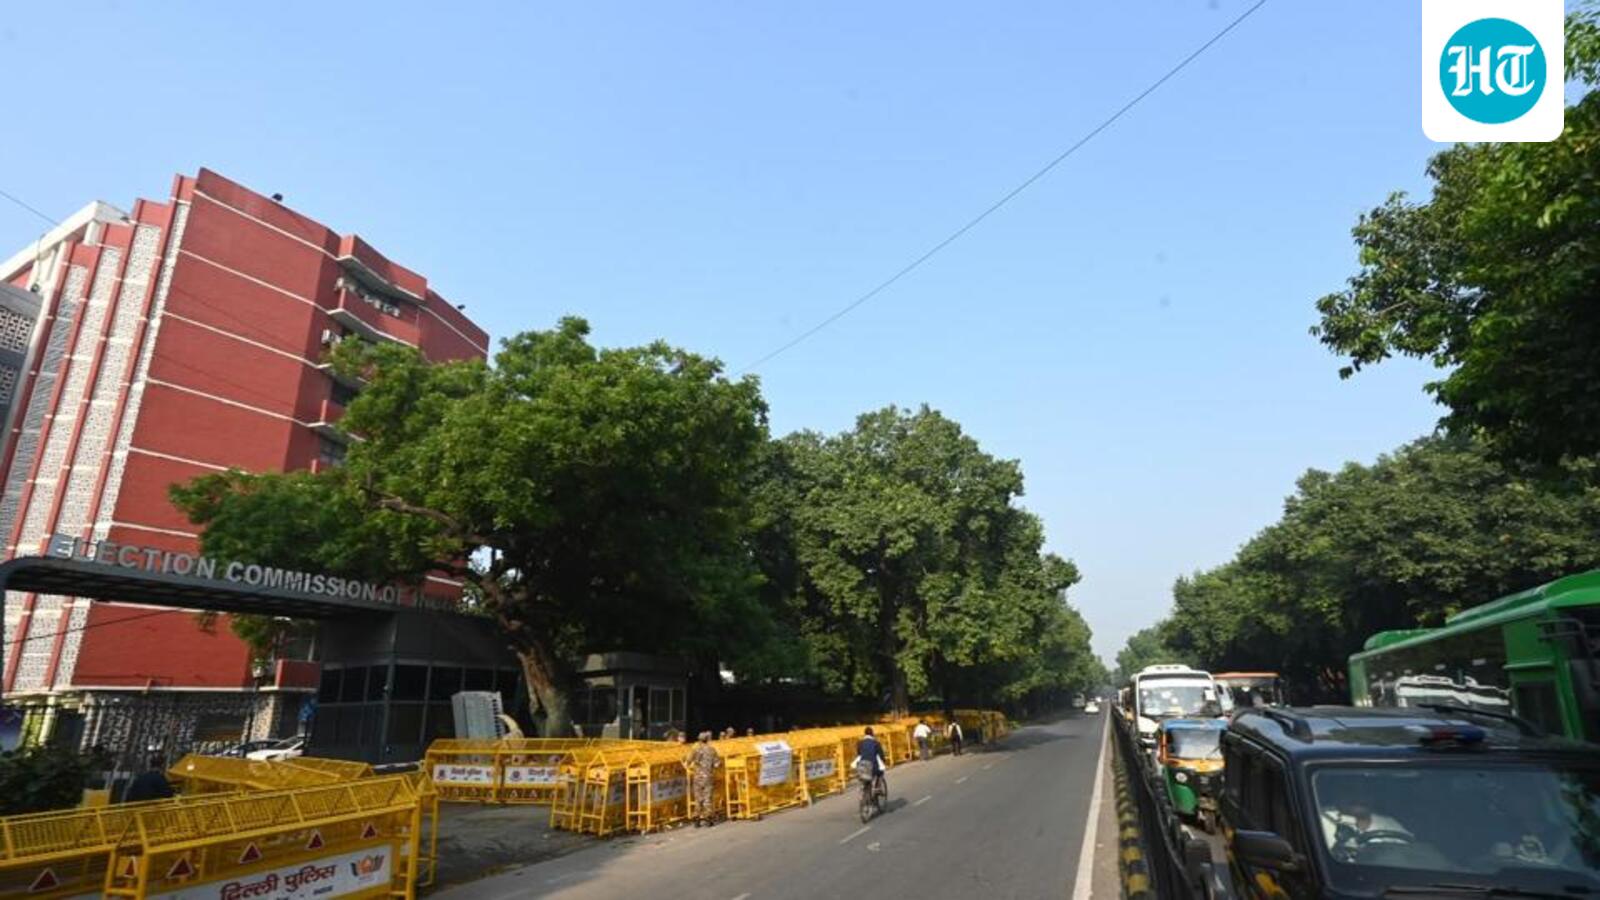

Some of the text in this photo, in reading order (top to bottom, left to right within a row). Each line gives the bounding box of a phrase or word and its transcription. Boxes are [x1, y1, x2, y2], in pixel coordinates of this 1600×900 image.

[51, 533, 216, 580] ELECTION
[226, 561, 377, 601] COMMISSION
[284, 865, 337, 893] पुलिस
